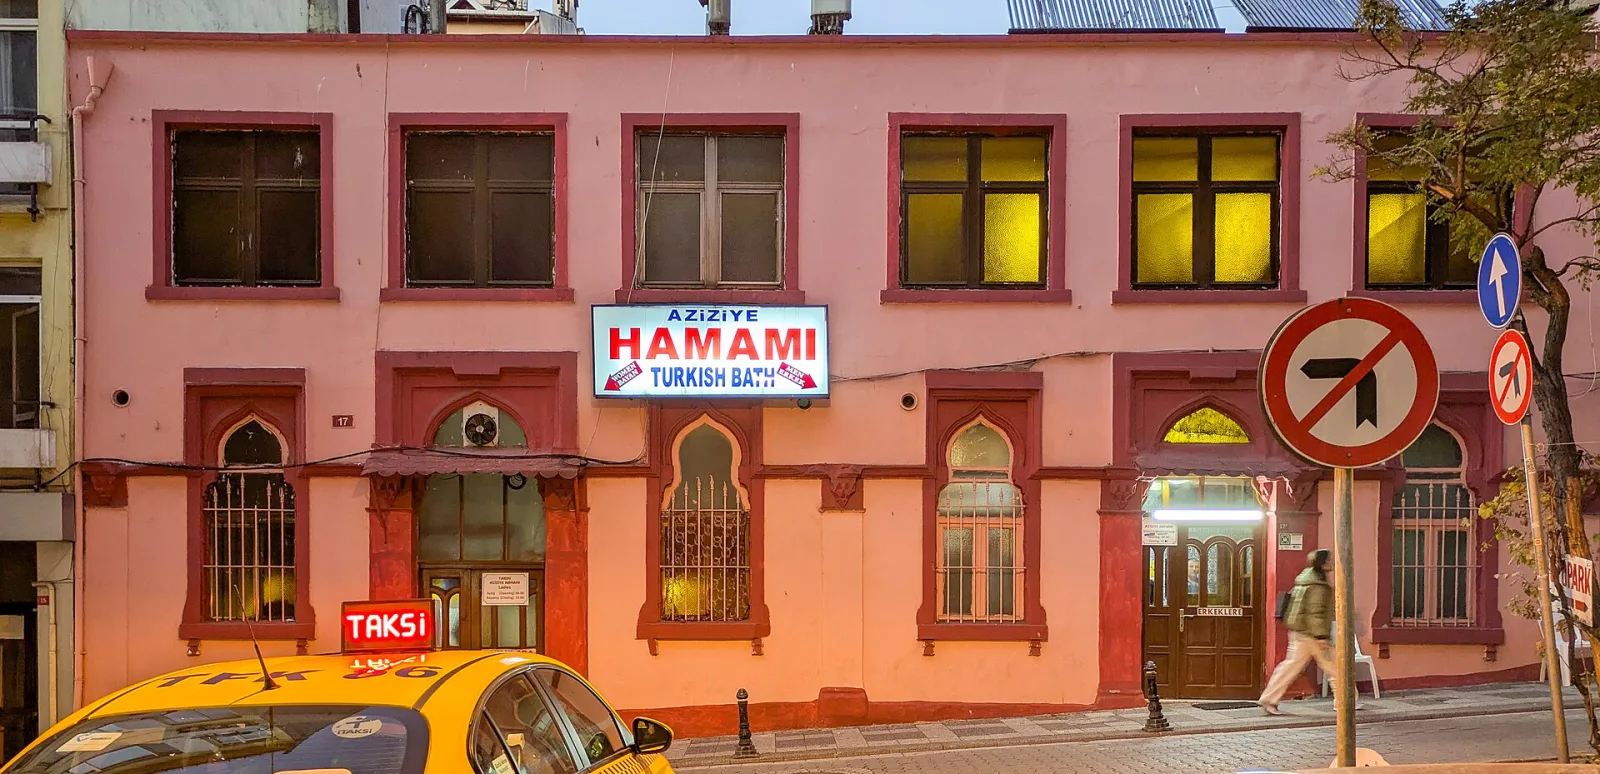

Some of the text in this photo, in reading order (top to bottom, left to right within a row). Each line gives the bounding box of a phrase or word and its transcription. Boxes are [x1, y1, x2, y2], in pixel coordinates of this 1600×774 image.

[609, 327, 816, 360] HAMAMI
[612, 362, 637, 382] WOMEN
[617, 369, 639, 387] BAYAN
[651, 366, 775, 388] TURKISH BATH
[785, 365, 805, 379] MEN
[338, 417, 349, 426] 17
[1198, 608, 1242, 616] ERKEKLERE
